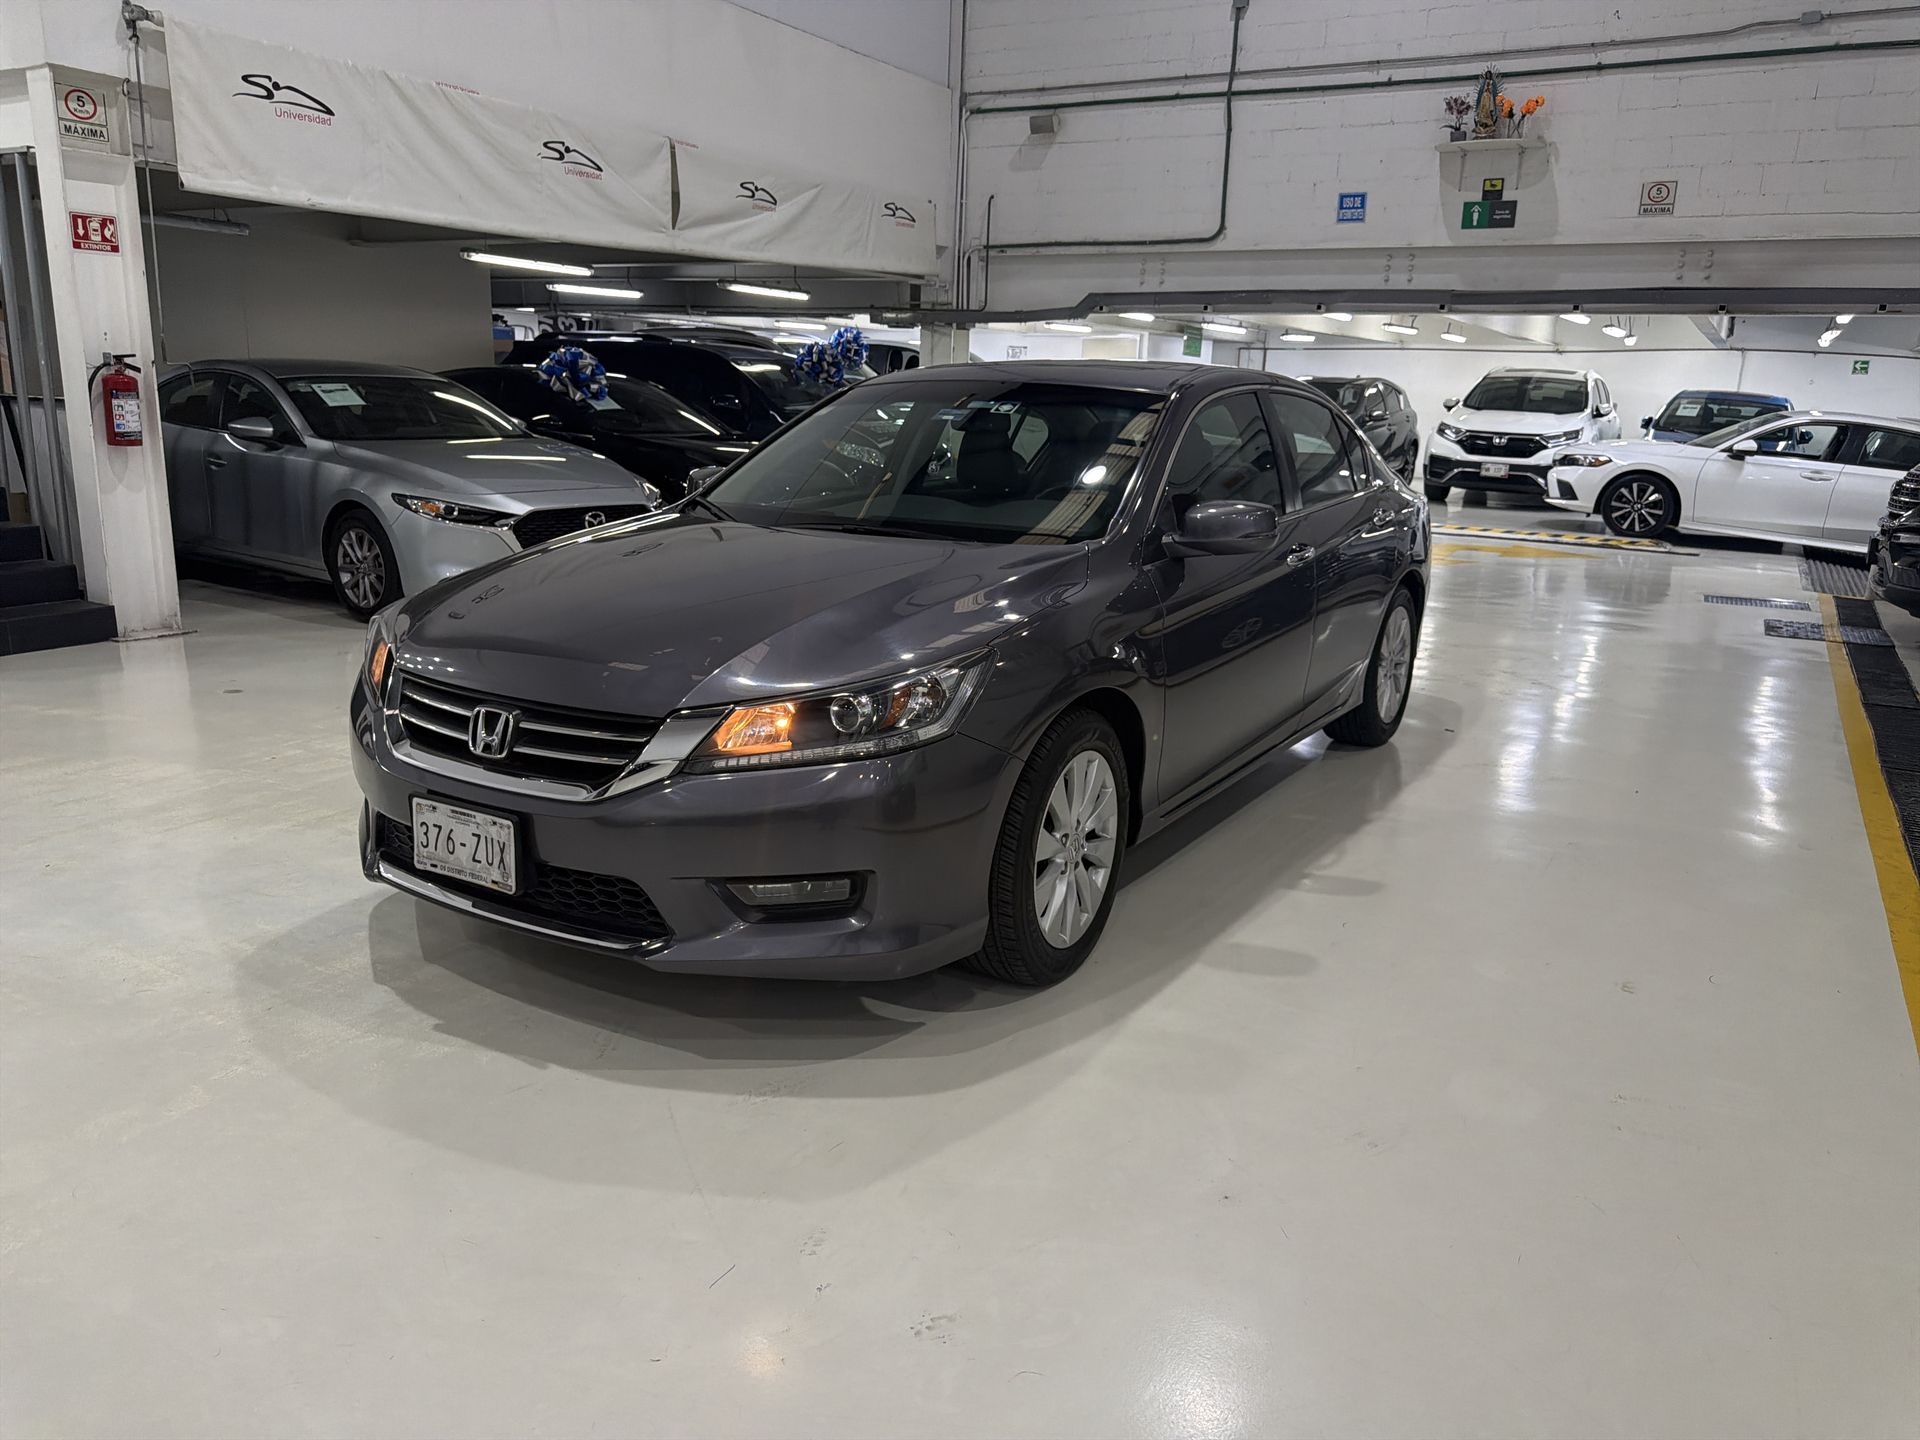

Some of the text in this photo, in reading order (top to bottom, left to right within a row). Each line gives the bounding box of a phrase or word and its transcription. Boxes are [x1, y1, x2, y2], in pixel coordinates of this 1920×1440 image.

[76, 95, 86, 108] 5
[274, 106, 332, 127] Universidad
[63, 122, 106, 140] MÁXIMA
[1655, 187, 1663, 196] 5
[1642, 205, 1671, 214] MÁXIMA
[80, 242, 112, 251] EXTINTOR
[420, 821, 507, 872] 376-ZUX
[447, 865, 468, 877] DISTRITO
[468, 870, 489, 883] FEDERAL
